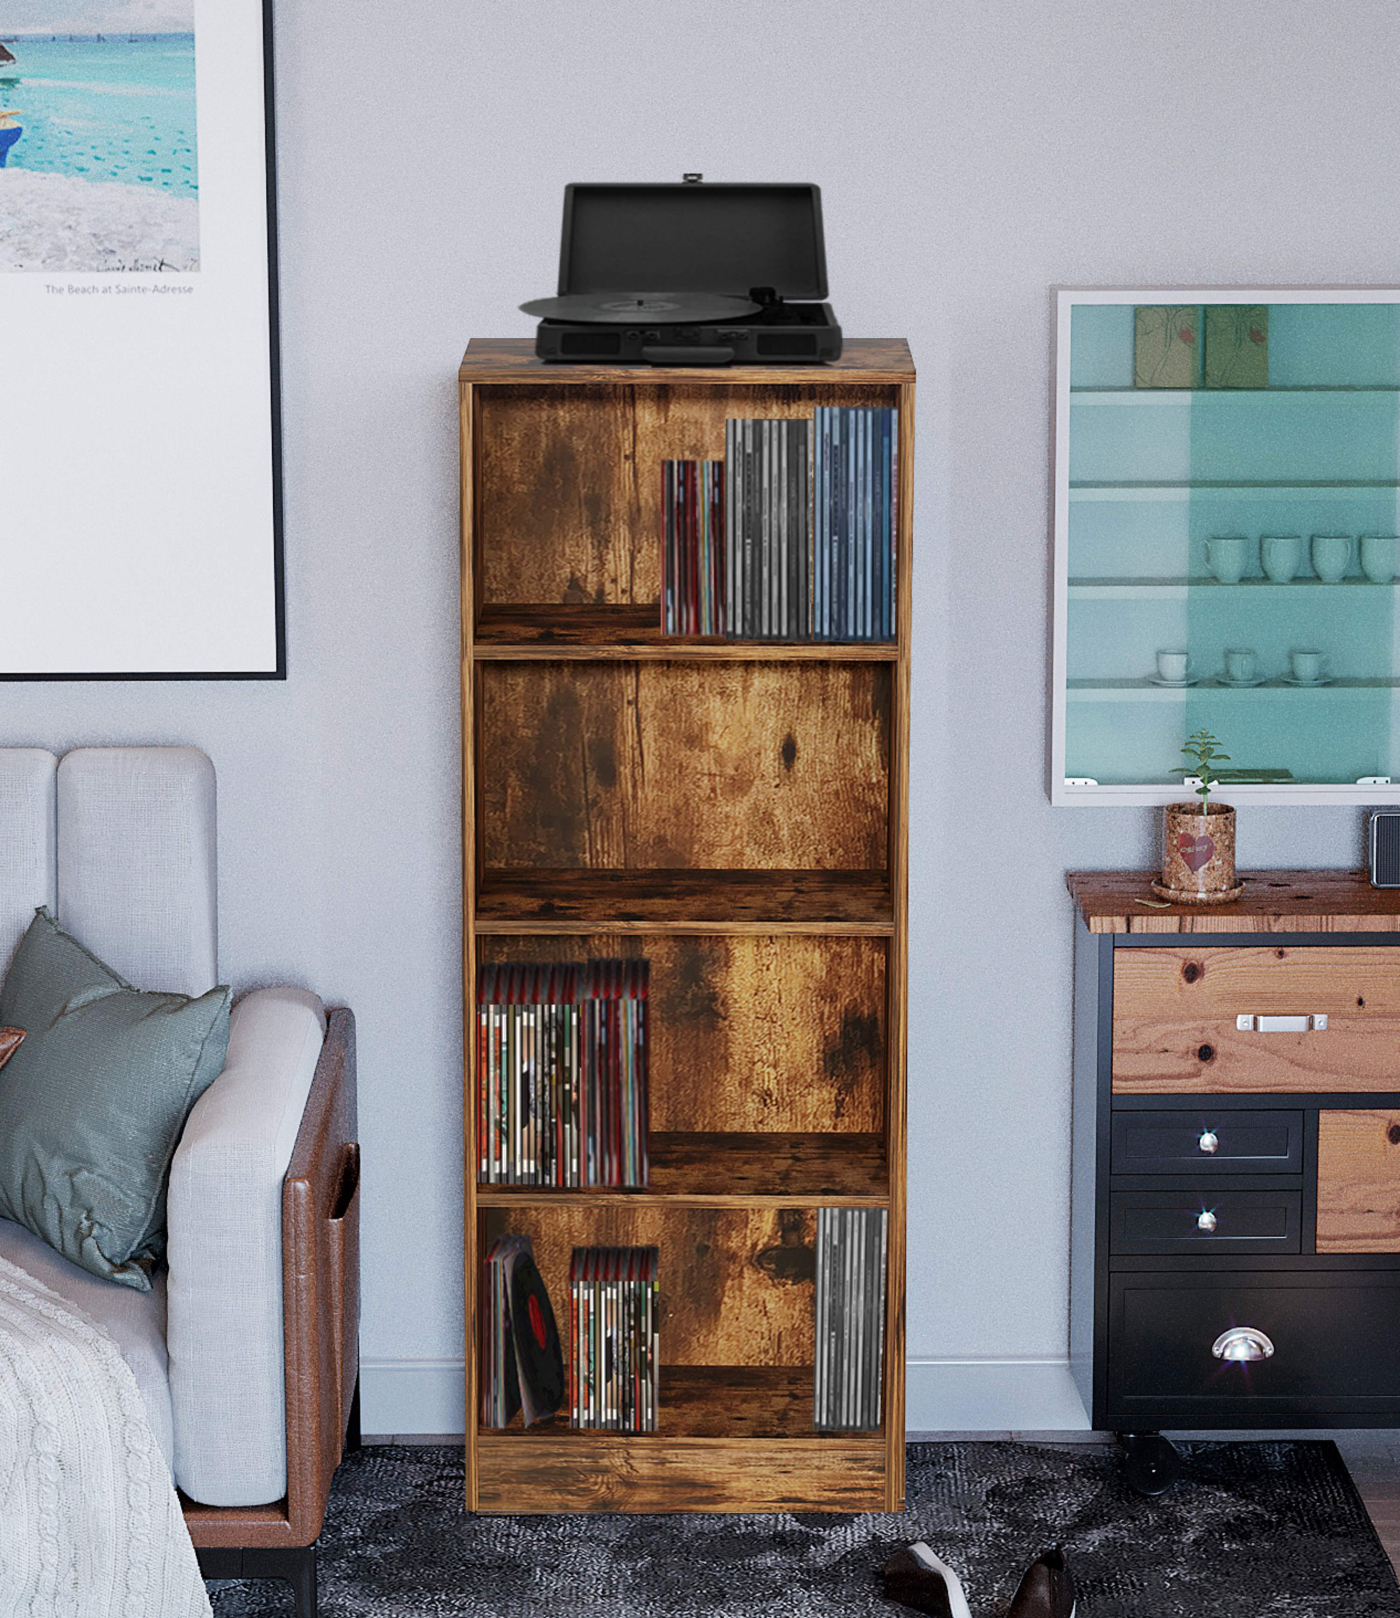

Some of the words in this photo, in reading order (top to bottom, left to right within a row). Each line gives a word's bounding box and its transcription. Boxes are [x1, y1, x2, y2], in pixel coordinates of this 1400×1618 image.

[45, 284, 64, 294] The
[67, 284, 99, 294] Beach
[101, 285, 112, 294] at
[115, 284, 194, 294] Sainte-Adresse
